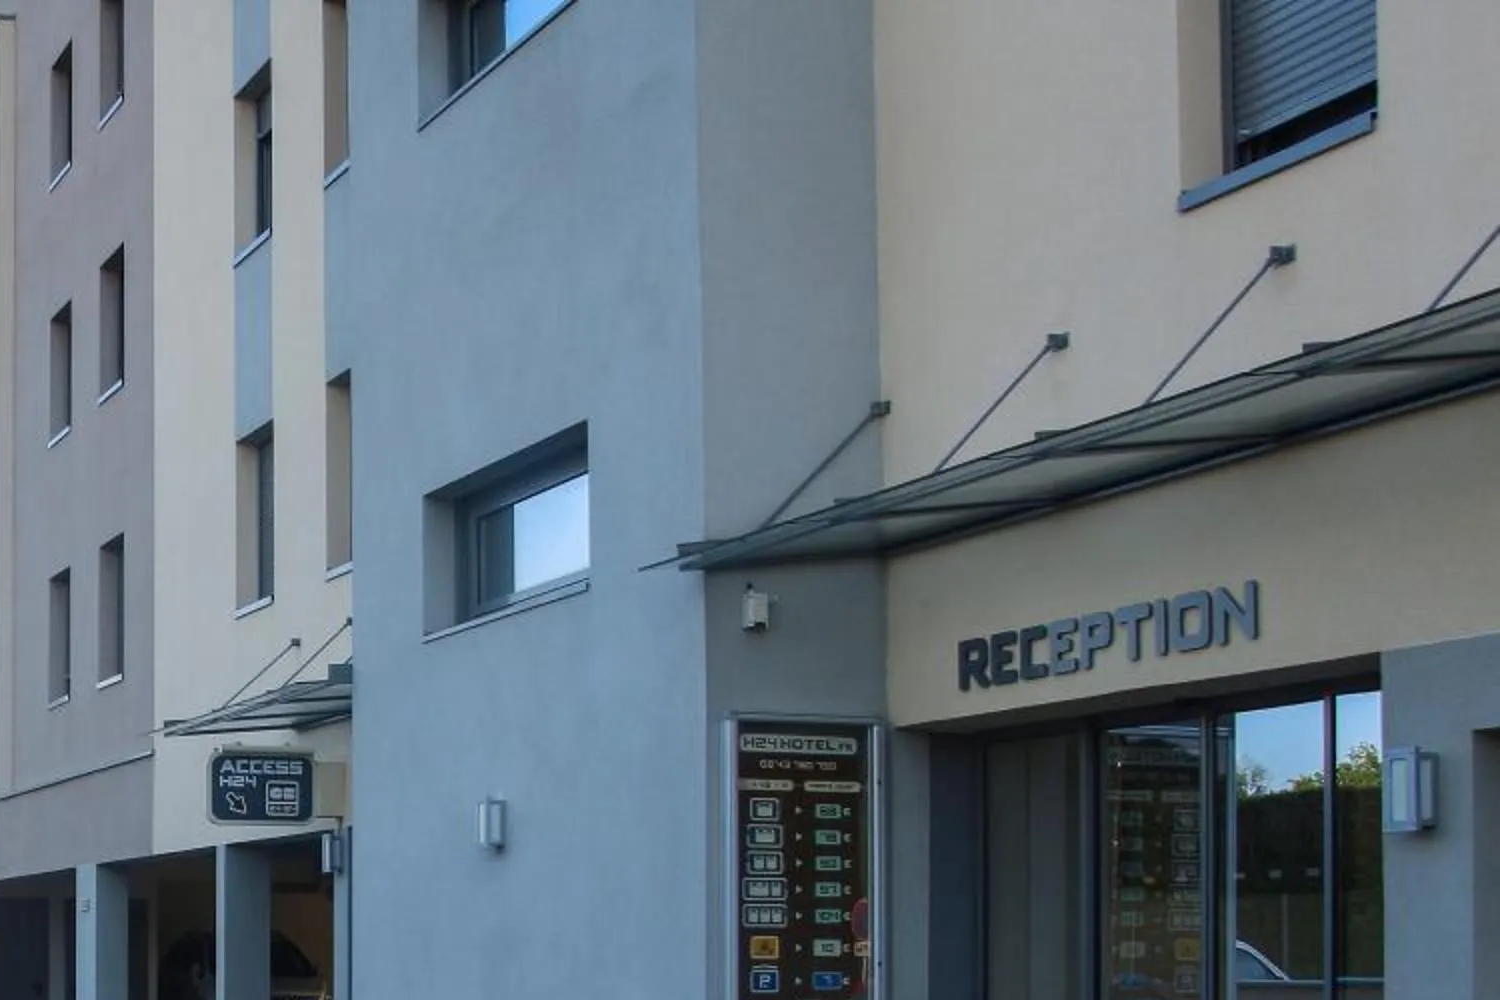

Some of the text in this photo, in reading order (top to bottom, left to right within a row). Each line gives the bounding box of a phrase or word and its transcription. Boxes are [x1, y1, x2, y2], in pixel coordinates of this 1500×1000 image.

[958, 579, 1260, 692] RECEPTION
[220, 759, 304, 775] ACCESS
[220, 775, 257, 788] H24
